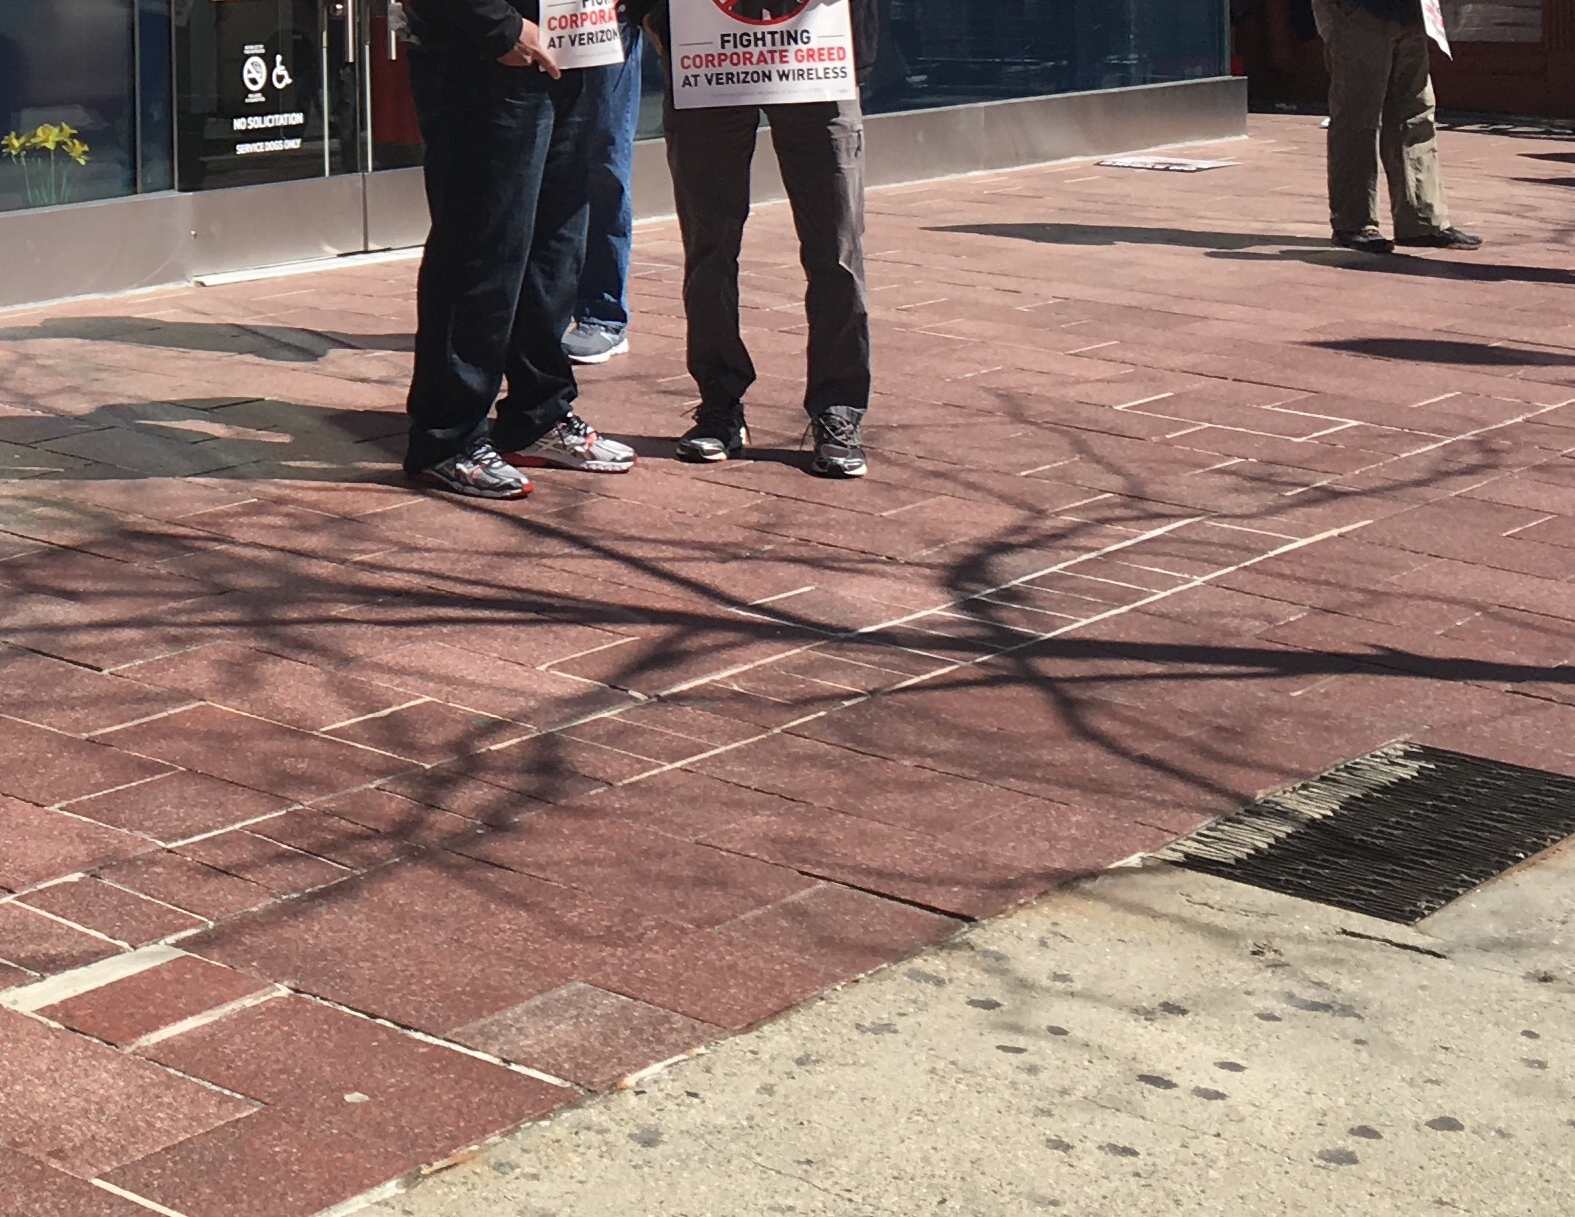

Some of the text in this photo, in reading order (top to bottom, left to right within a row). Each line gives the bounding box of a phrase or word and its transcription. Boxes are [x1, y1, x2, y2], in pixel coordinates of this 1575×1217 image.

[547, 35, 565, 49] AT
[719, 29, 811, 50] FIGHTING
[680, 46, 846, 71] CORPORATE GREED
[681, 66, 848, 88] AT VERIZON WIRELESS
[233, 112, 304, 130] NO SOLICITATION
